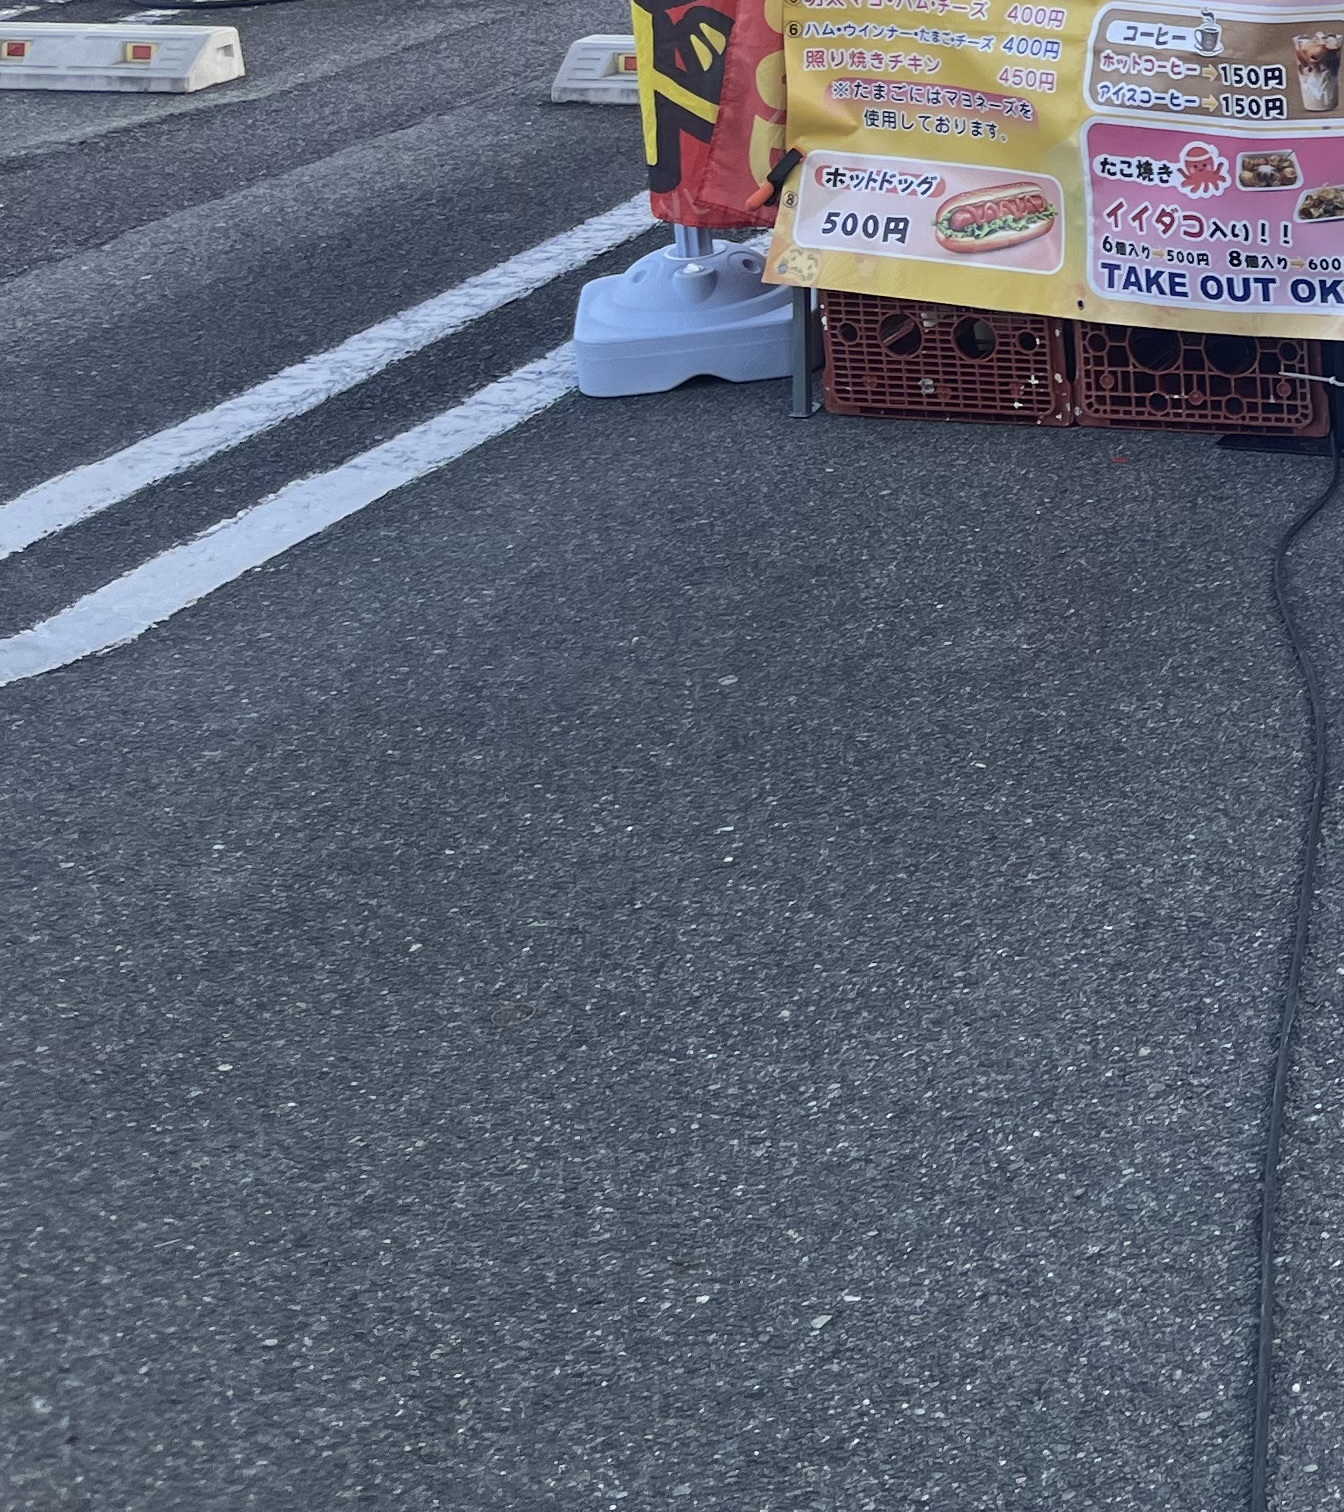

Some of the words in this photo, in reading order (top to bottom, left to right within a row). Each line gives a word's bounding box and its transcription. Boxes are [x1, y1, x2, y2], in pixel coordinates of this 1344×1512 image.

[1006, 4, 1067, 29] 400円
[1002, 38, 1062, 61] 400円
[1122, 24, 1187, 47] コーヒー
[804, 49, 942, 73] 照り焼きチキン
[1100, 50, 1200, 77] ホットコーヒー
[1219, 64, 1286, 89] 150円
[998, 66, 1058, 92] 450円
[1097, 82, 1200, 108] アイスコーヒー
[1221, 94, 1287, 119] 150円
[863, 108, 1008, 143] 使用しております。
[823, 166, 940, 200] ホットドッグ
[1099, 156, 1175, 185] たこ焼き
[820, 211, 911, 245] 500円
[1165, 248, 1210, 266] 500円
[1100, 261, 1190, 298] TAKE
[1199, 274, 1277, 303] OUT
